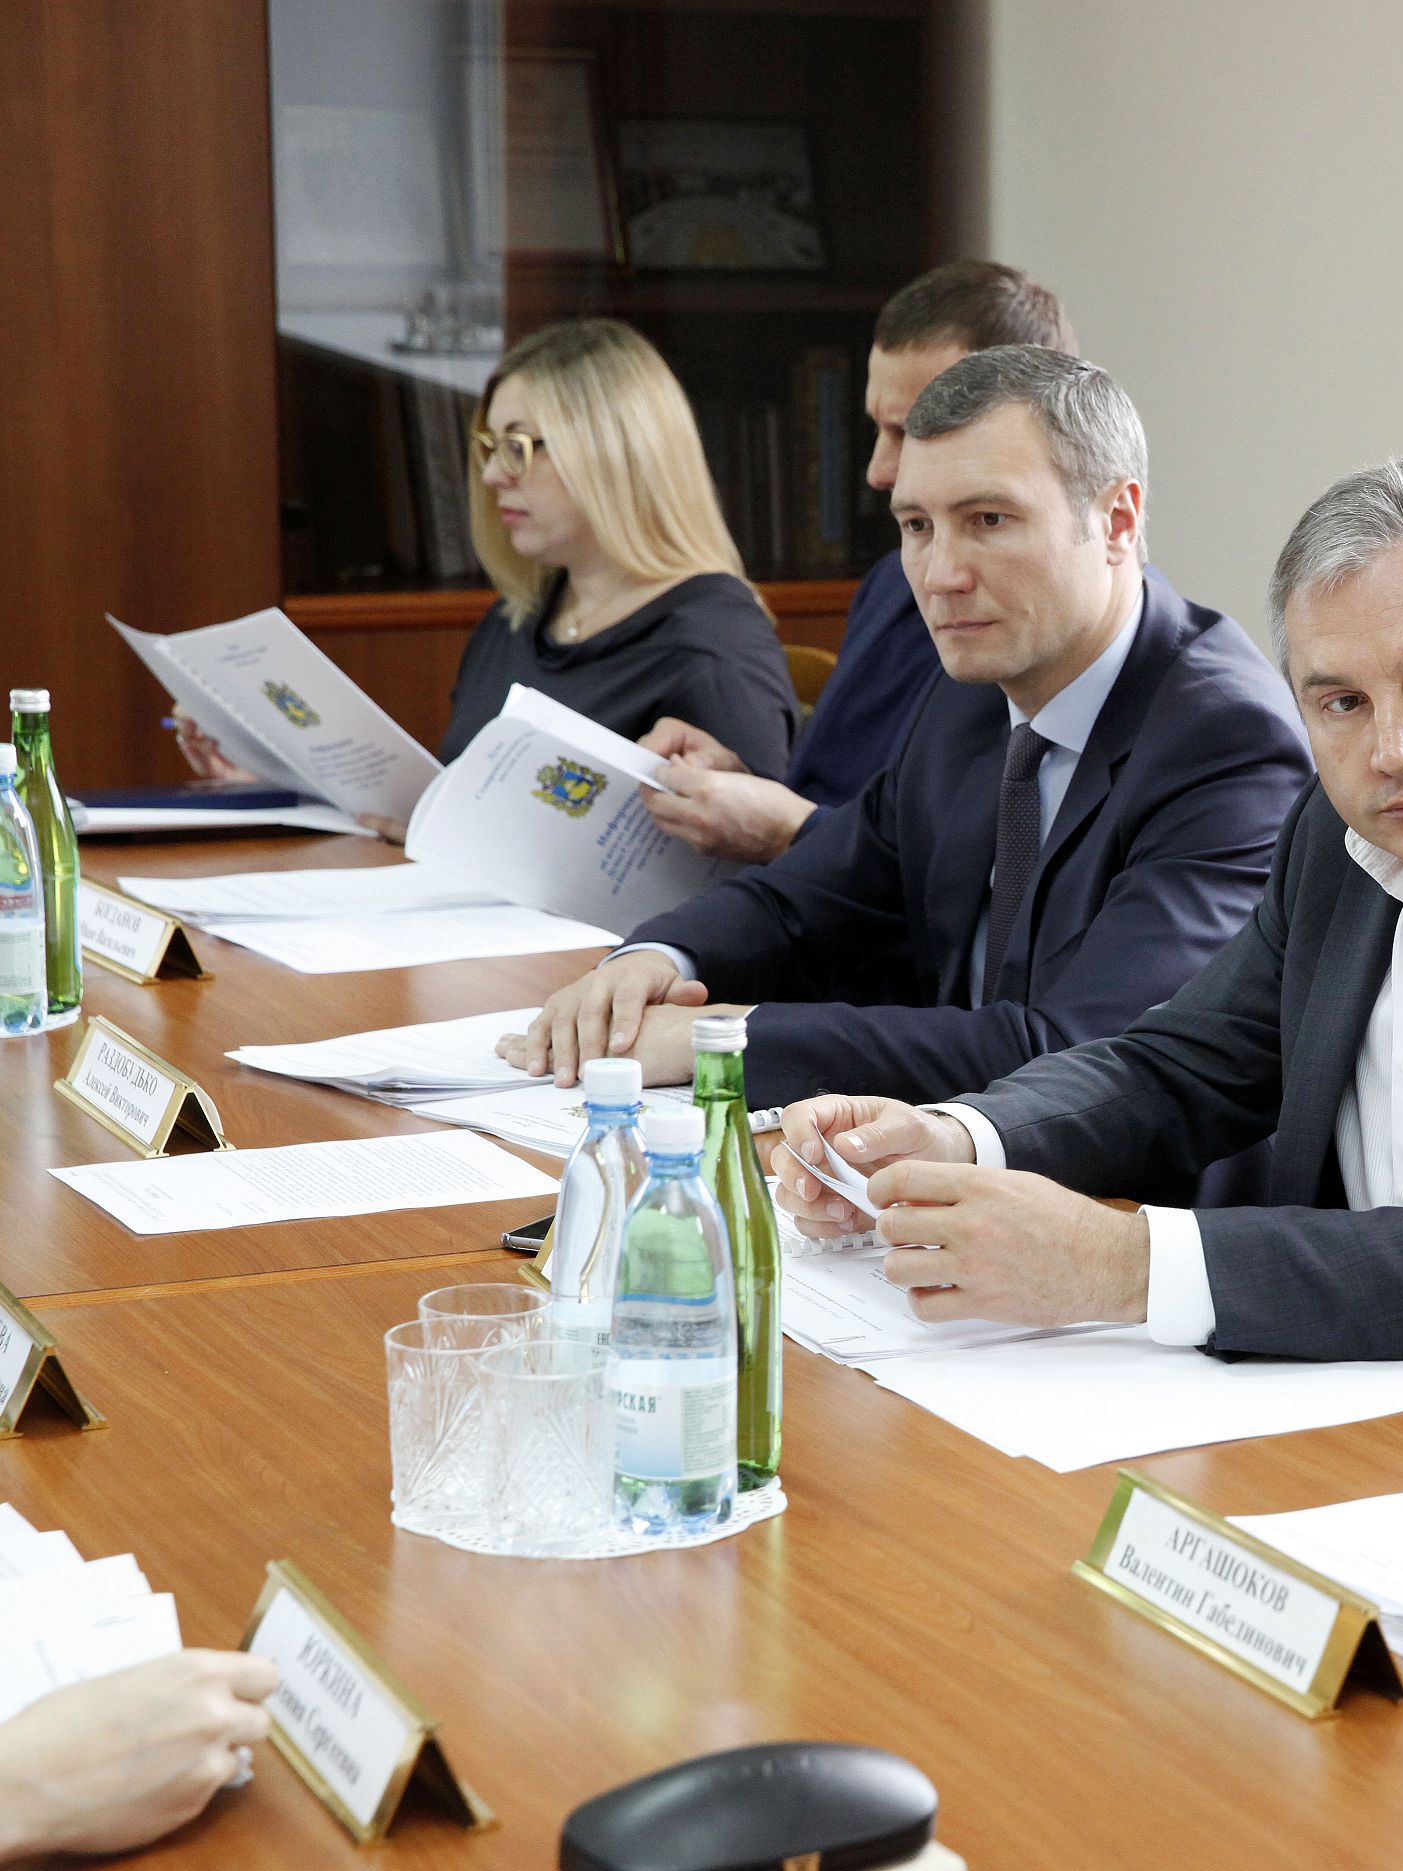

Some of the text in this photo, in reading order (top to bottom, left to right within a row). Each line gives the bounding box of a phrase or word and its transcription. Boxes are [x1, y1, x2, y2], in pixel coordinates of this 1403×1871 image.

[83, 1070, 150, 1127] Алексей Викторович
[97, 1042, 158, 1096] РАЗДОБУДЬКО
[1119, 1545, 1195, 1606] Валентин
[1167, 1527, 1290, 1613] АРГАШОКОВ
